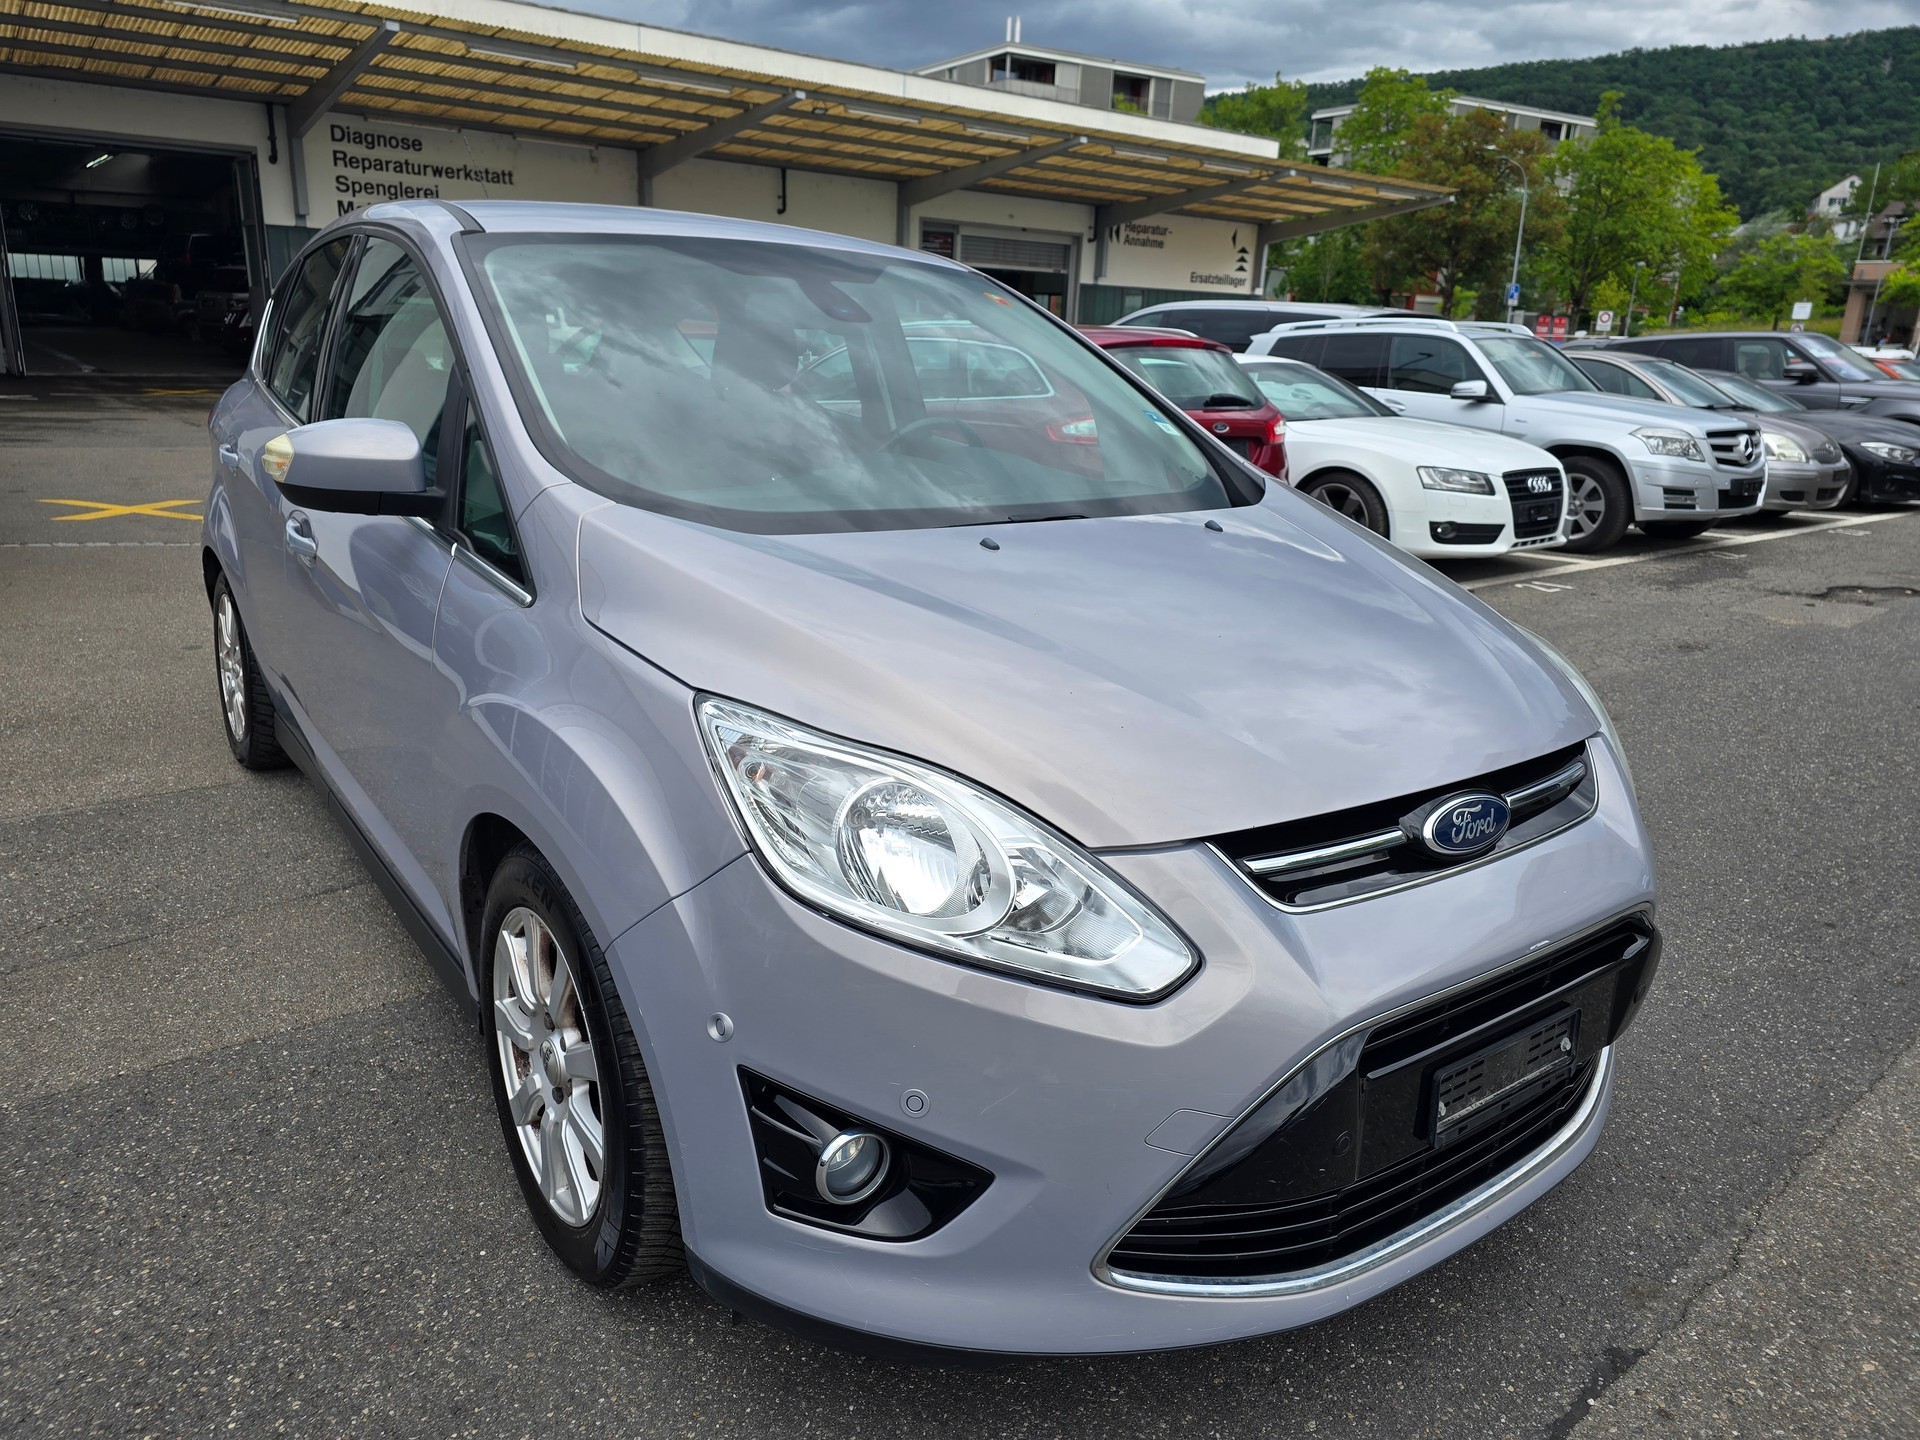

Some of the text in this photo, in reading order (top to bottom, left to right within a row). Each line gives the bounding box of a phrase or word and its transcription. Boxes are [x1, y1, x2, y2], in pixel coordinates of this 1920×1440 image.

[330, 124, 423, 151] Diagnose
[332, 150, 514, 185] Reparaturwerkstatt
[335, 175, 439, 200] Spenglerei
[1123, 234, 1164, 249] Annahme
[1190, 271, 1247, 288] Ersatzteillager
[1451, 804, 1496, 843] Ford
